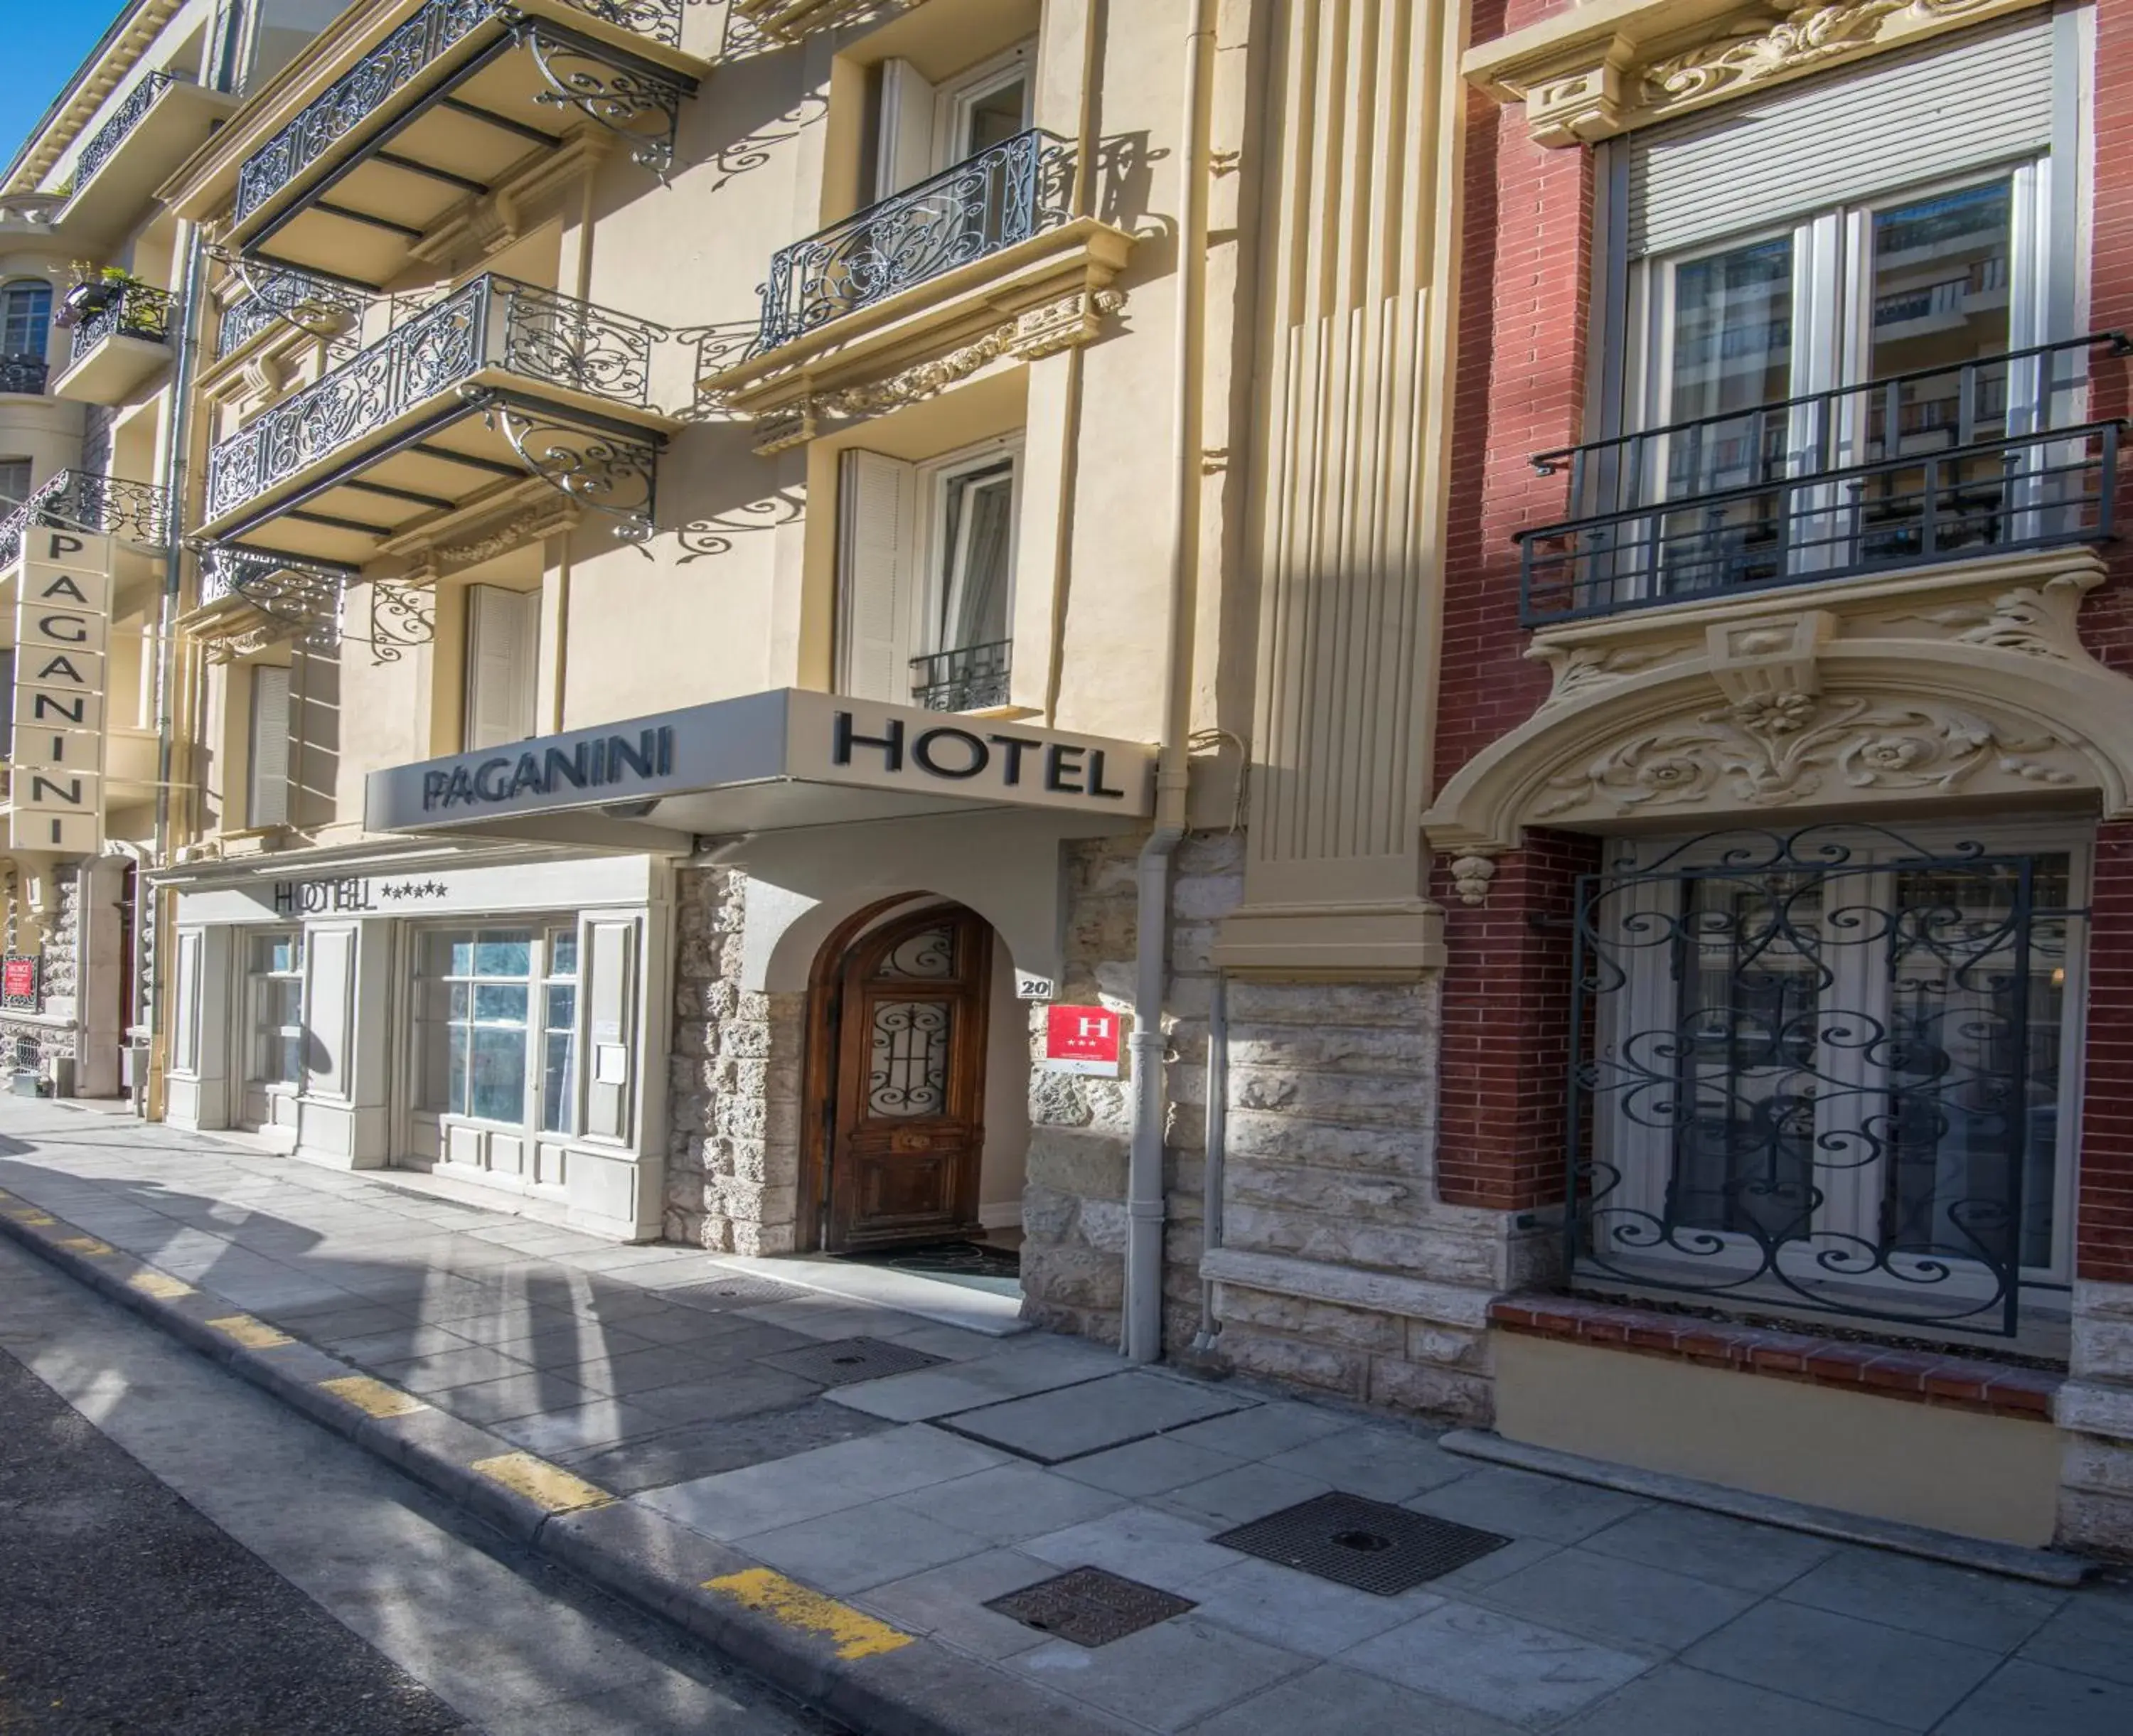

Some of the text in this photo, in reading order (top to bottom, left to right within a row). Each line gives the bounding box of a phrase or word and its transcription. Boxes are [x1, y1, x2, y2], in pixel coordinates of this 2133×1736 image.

[33, 534, 90, 844] PAGANINI
[422, 724, 675, 811] PAGANINI
[833, 711, 1124, 798] HOTEL
[274, 875, 373, 913] HOTEL
[1022, 980, 1048, 995] 20
[1079, 1017, 1110, 1039] H
